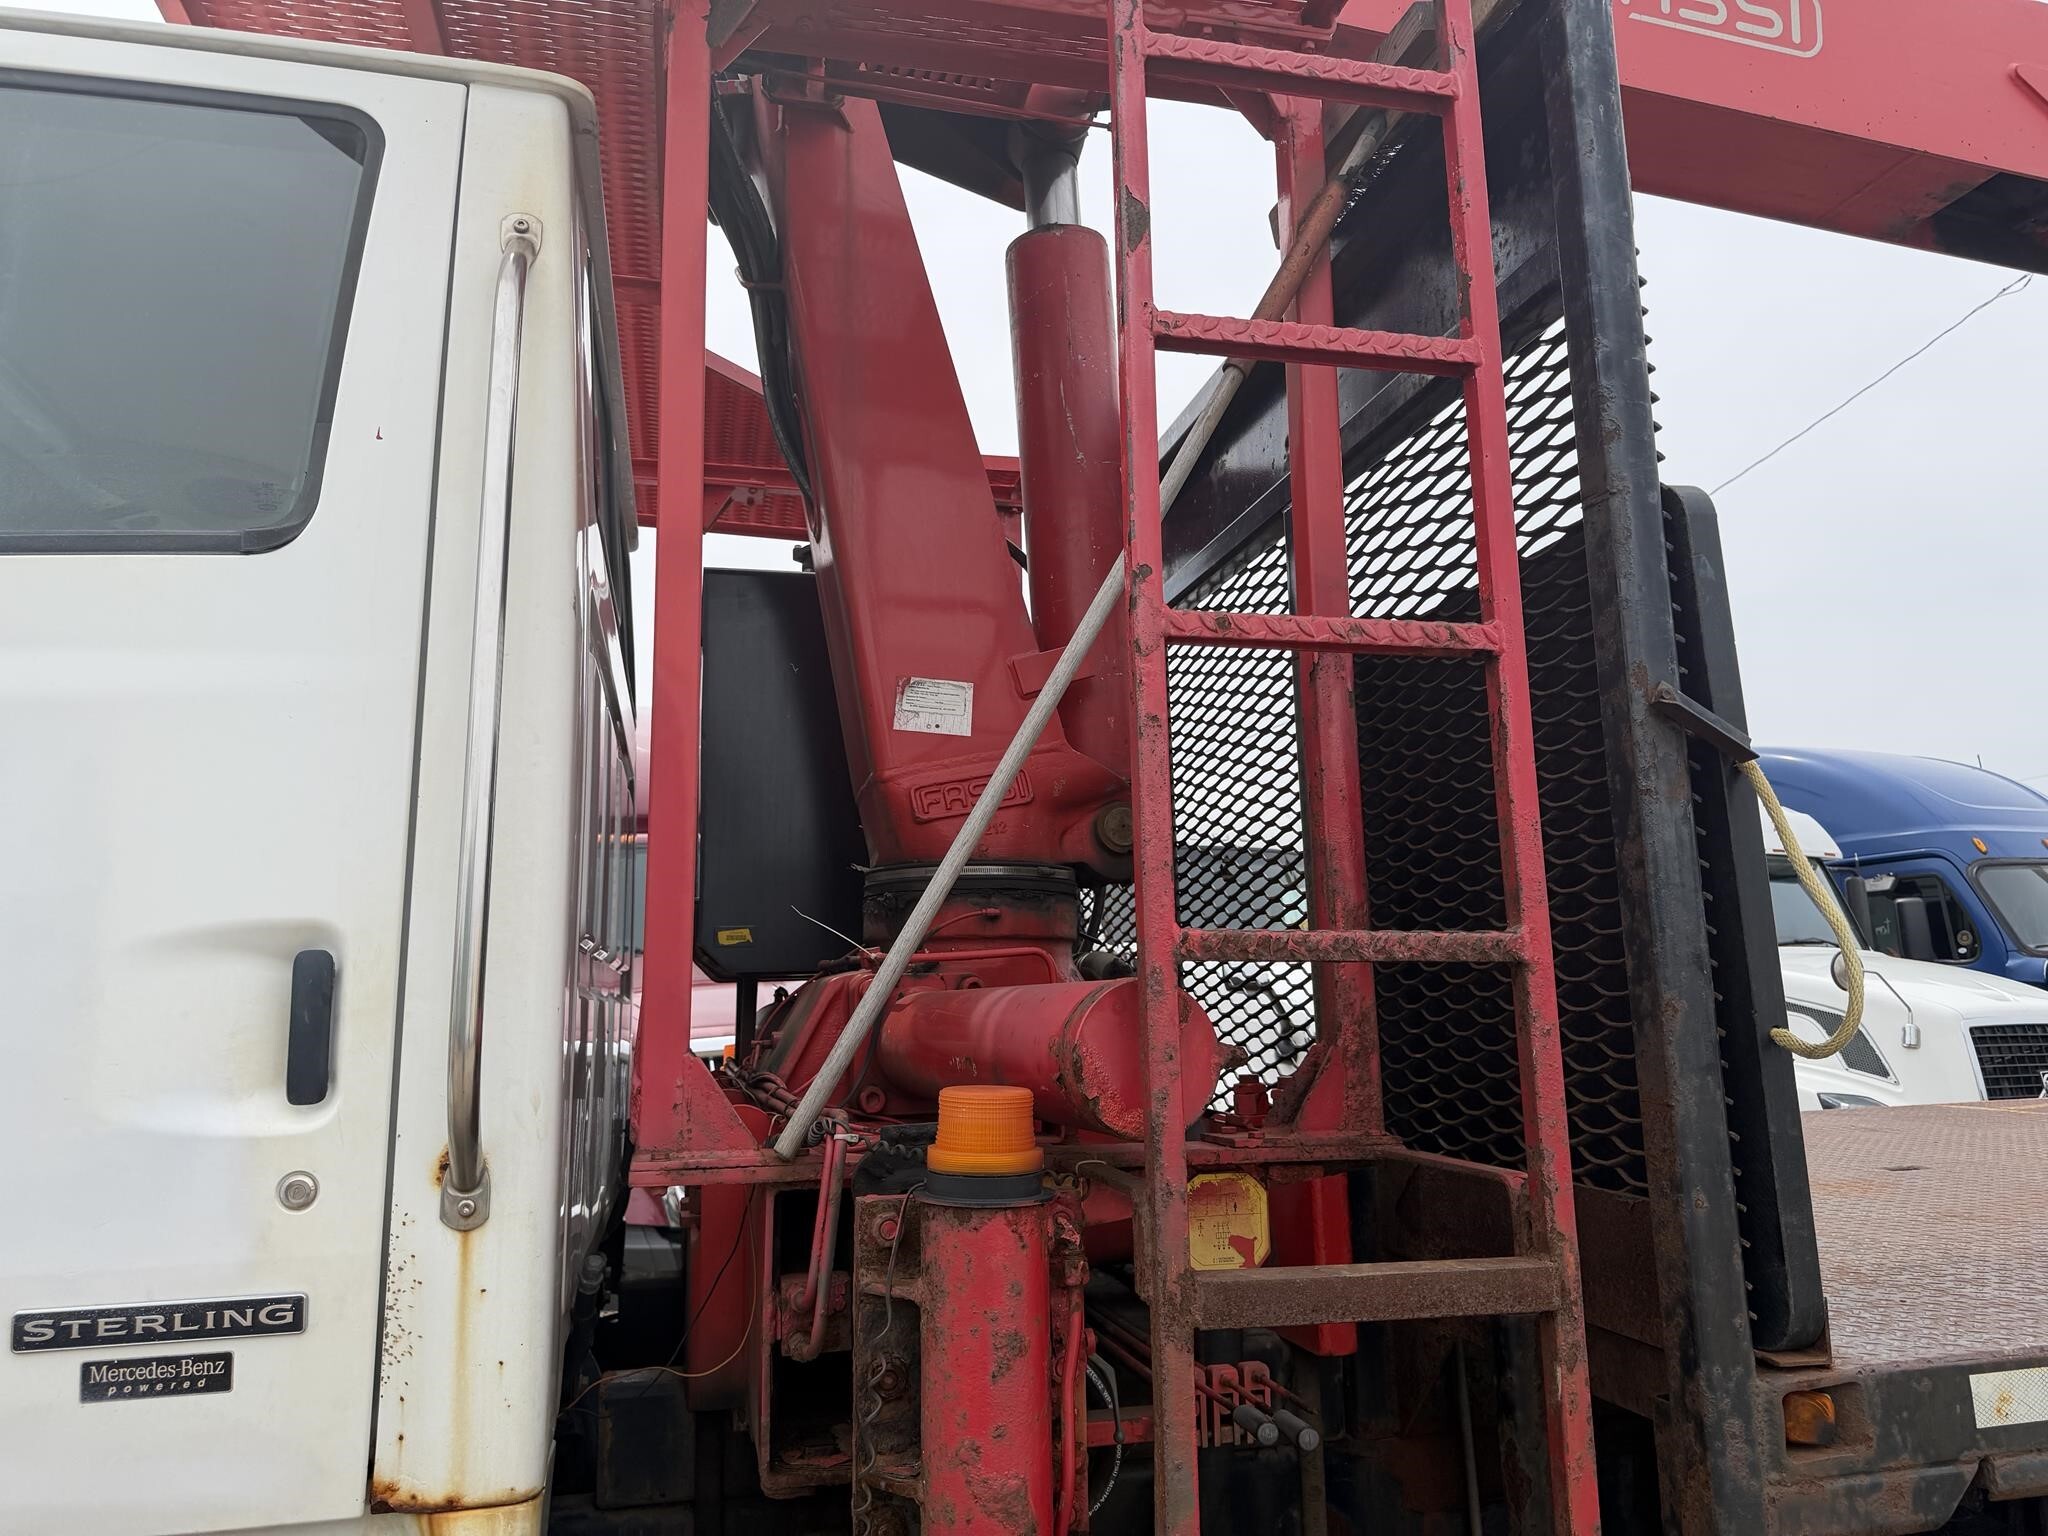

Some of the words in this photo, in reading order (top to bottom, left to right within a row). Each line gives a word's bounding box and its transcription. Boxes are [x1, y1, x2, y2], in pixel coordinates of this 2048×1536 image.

[22, 1303, 296, 1343] STERLING
[88, 1359, 226, 1384] Mercedes-Benz
[107, 1377, 207, 1397] powered
